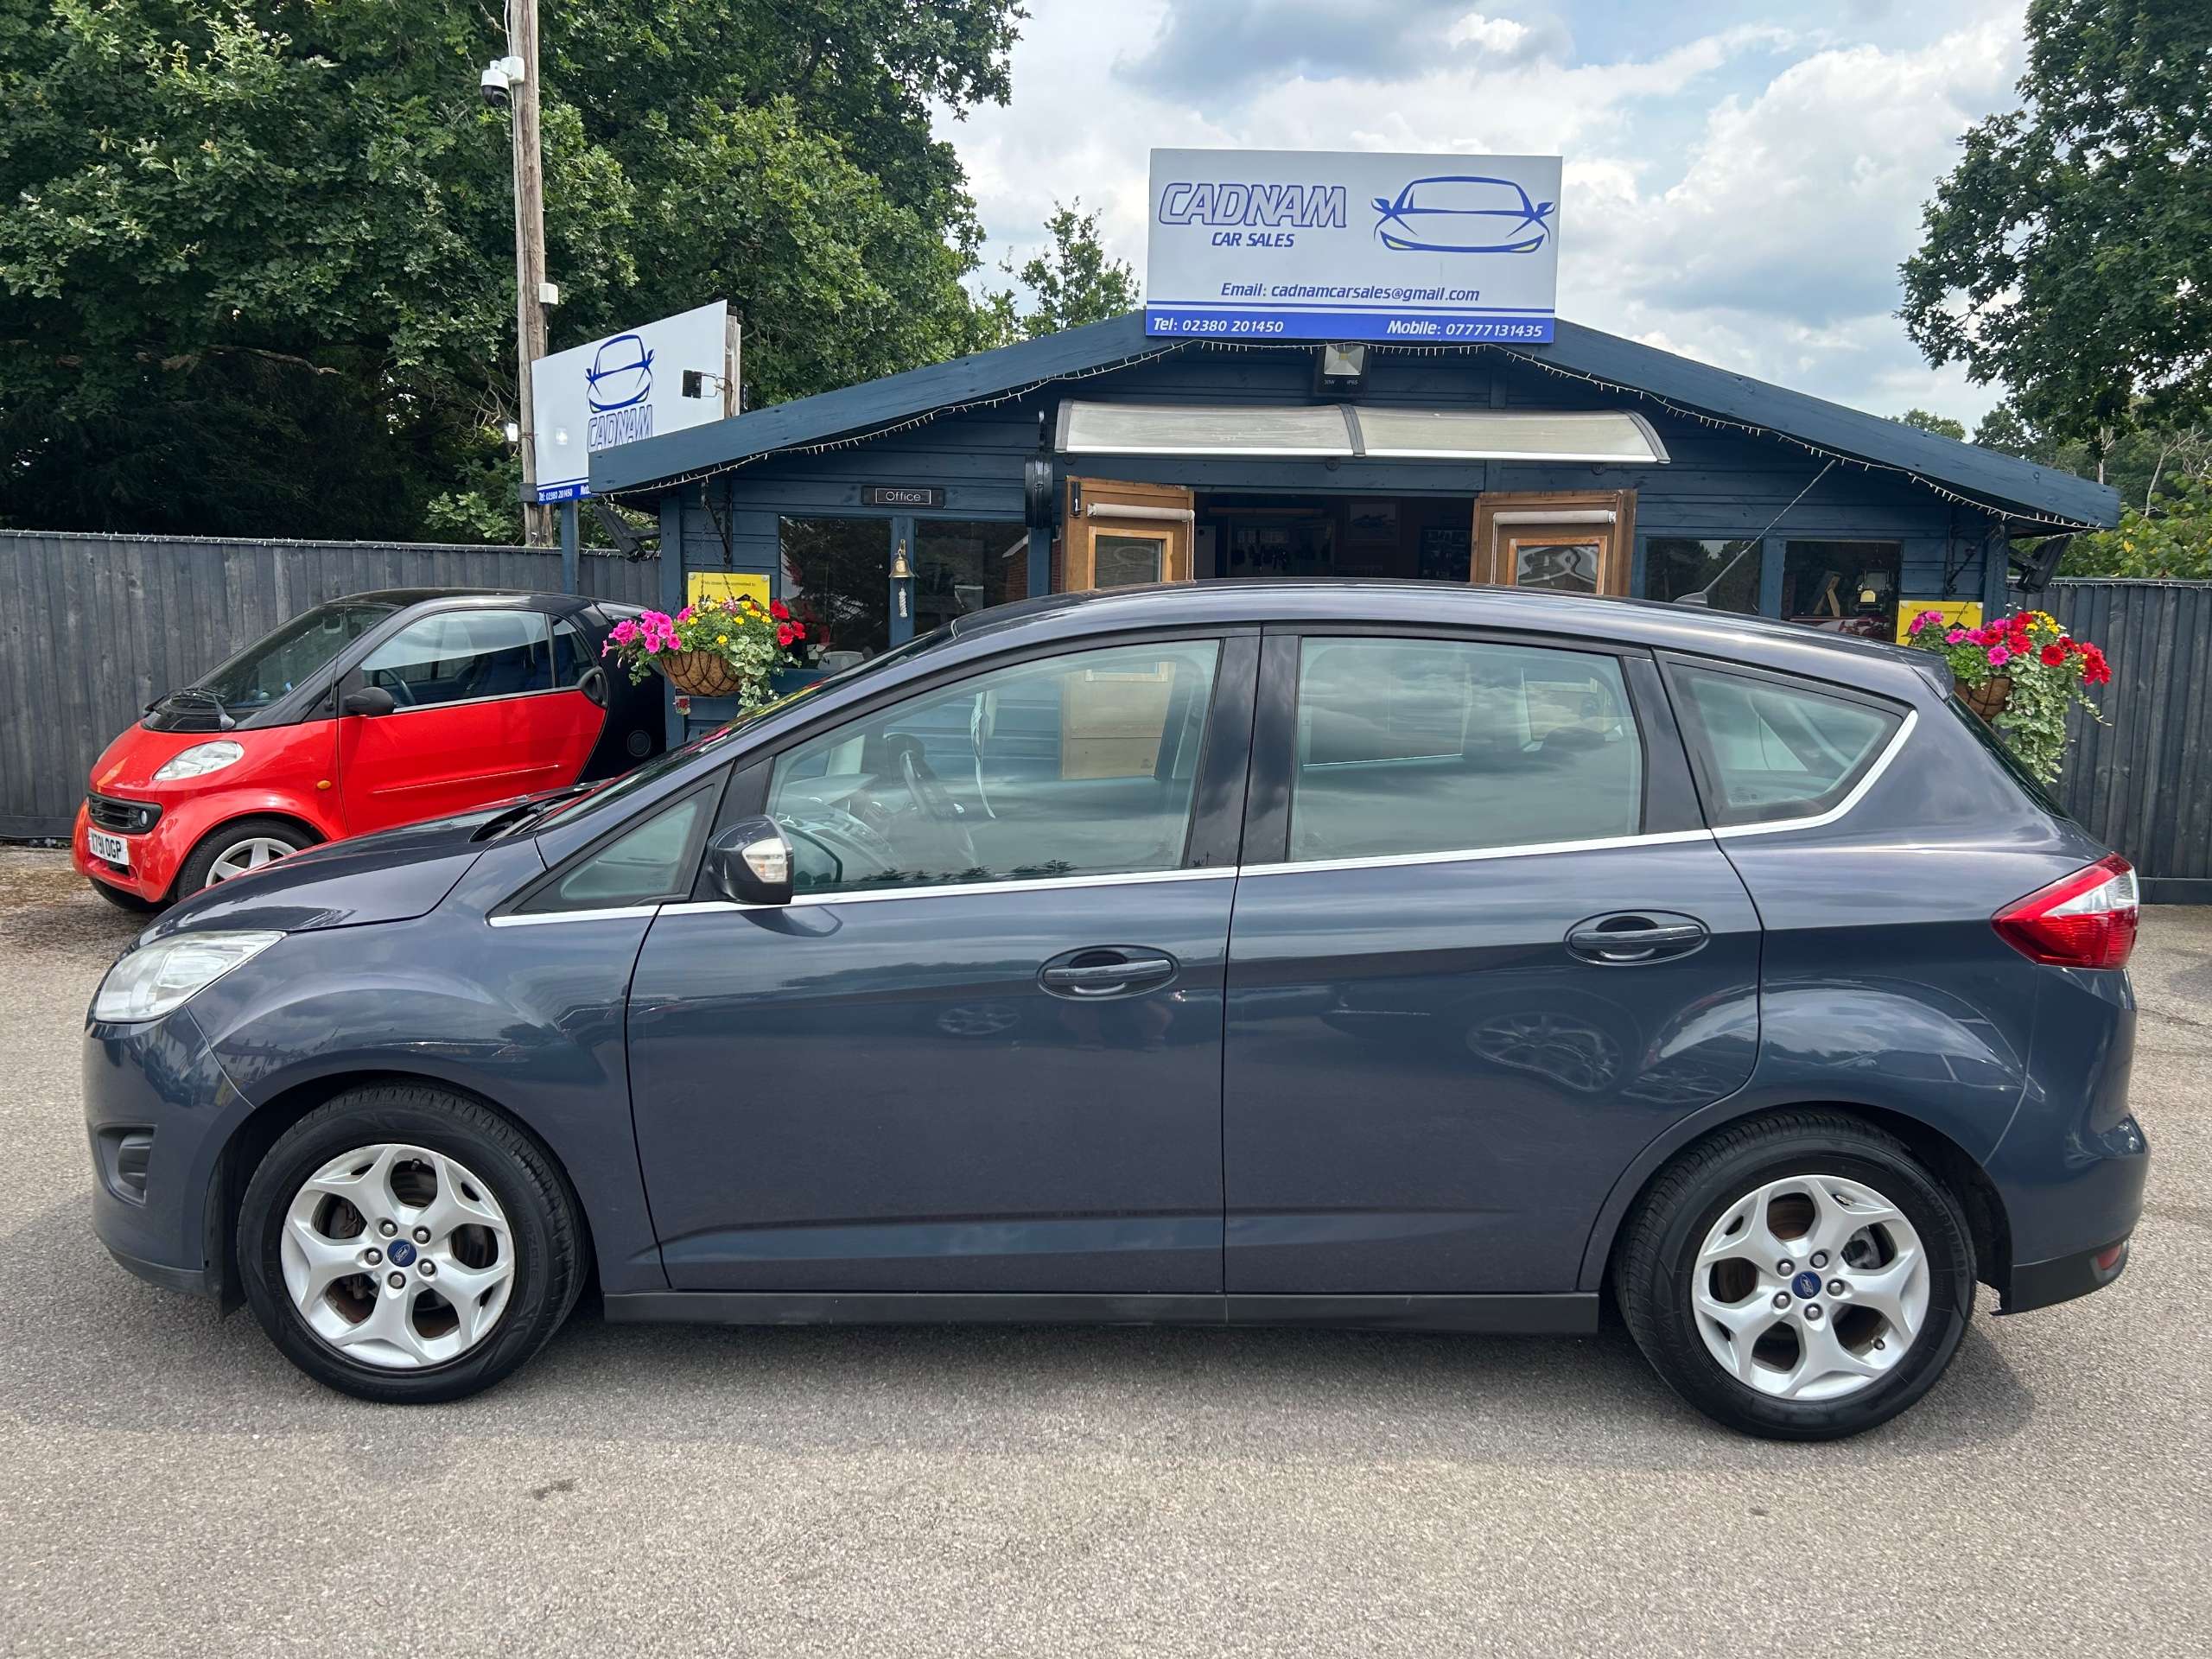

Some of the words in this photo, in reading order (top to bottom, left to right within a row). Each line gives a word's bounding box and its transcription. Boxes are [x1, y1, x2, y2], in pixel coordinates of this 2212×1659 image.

[1159, 183, 1346, 228] CADNAM
[1211, 232, 1242, 246] CAR
[1246, 232, 1294, 248] SALES
[1221, 283, 1267, 296] Email:
[1271, 283, 1480, 302] cadnamcarsales@gmail.com
[1154, 317, 1178, 331] Tel:
[1182, 320, 1227, 332] 02380
[1230, 321, 1284, 333] 201450
[1387, 320, 1441, 335] Mobile:
[1446, 323, 1543, 337] 07777131435
[588, 404, 653, 454] CADNAM
[886, 491, 921, 501] Office
[105, 837, 121, 860] OGP
